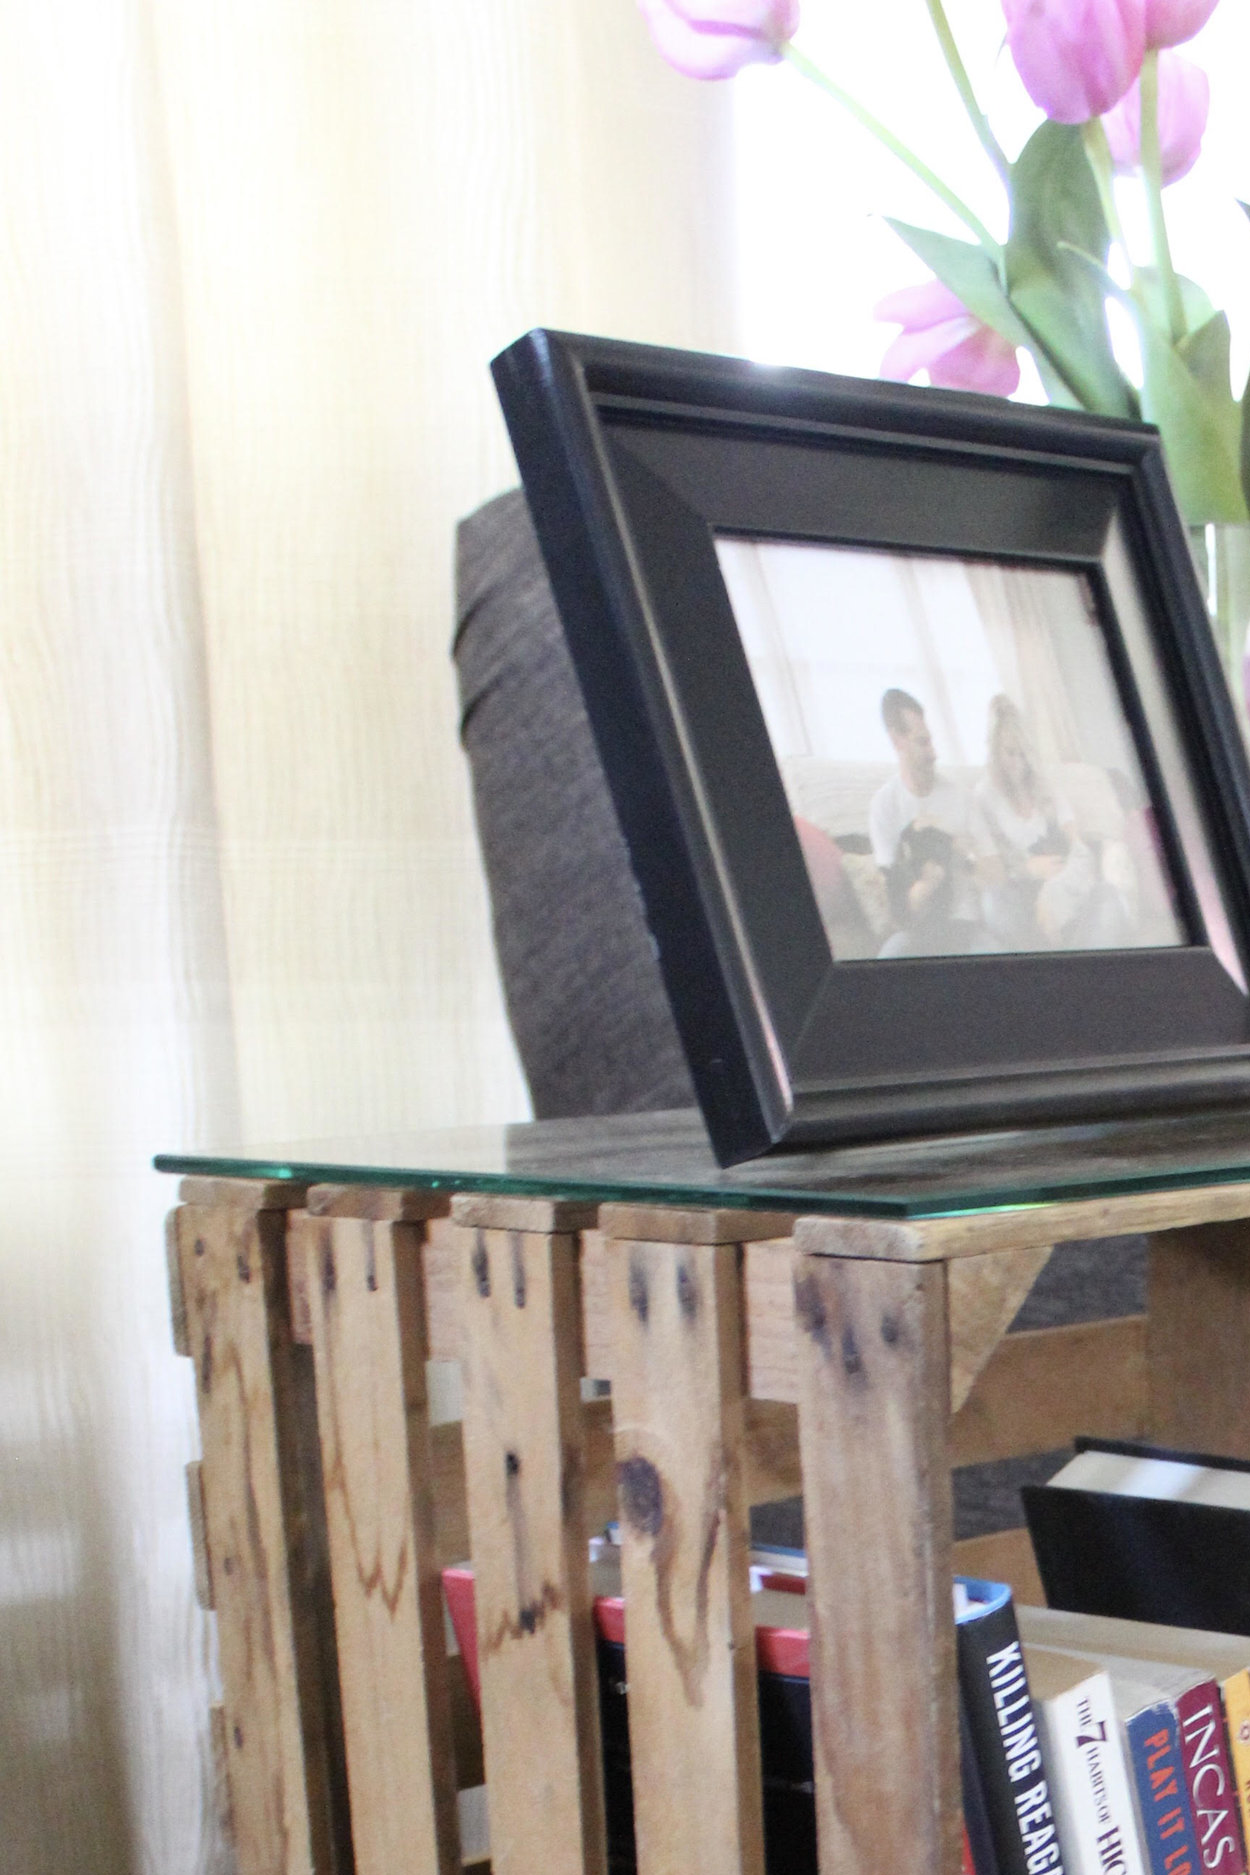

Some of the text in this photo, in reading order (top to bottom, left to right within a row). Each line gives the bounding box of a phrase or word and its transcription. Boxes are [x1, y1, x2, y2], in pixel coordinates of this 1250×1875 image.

[986, 1641, 1042, 1783] KILLING
[1075, 1720, 1108, 1748] 7
[1144, 1728, 1178, 1802] PLAY
[1182, 1703, 1236, 1869] INCAS
[1157, 1806, 1185, 1840] IT
